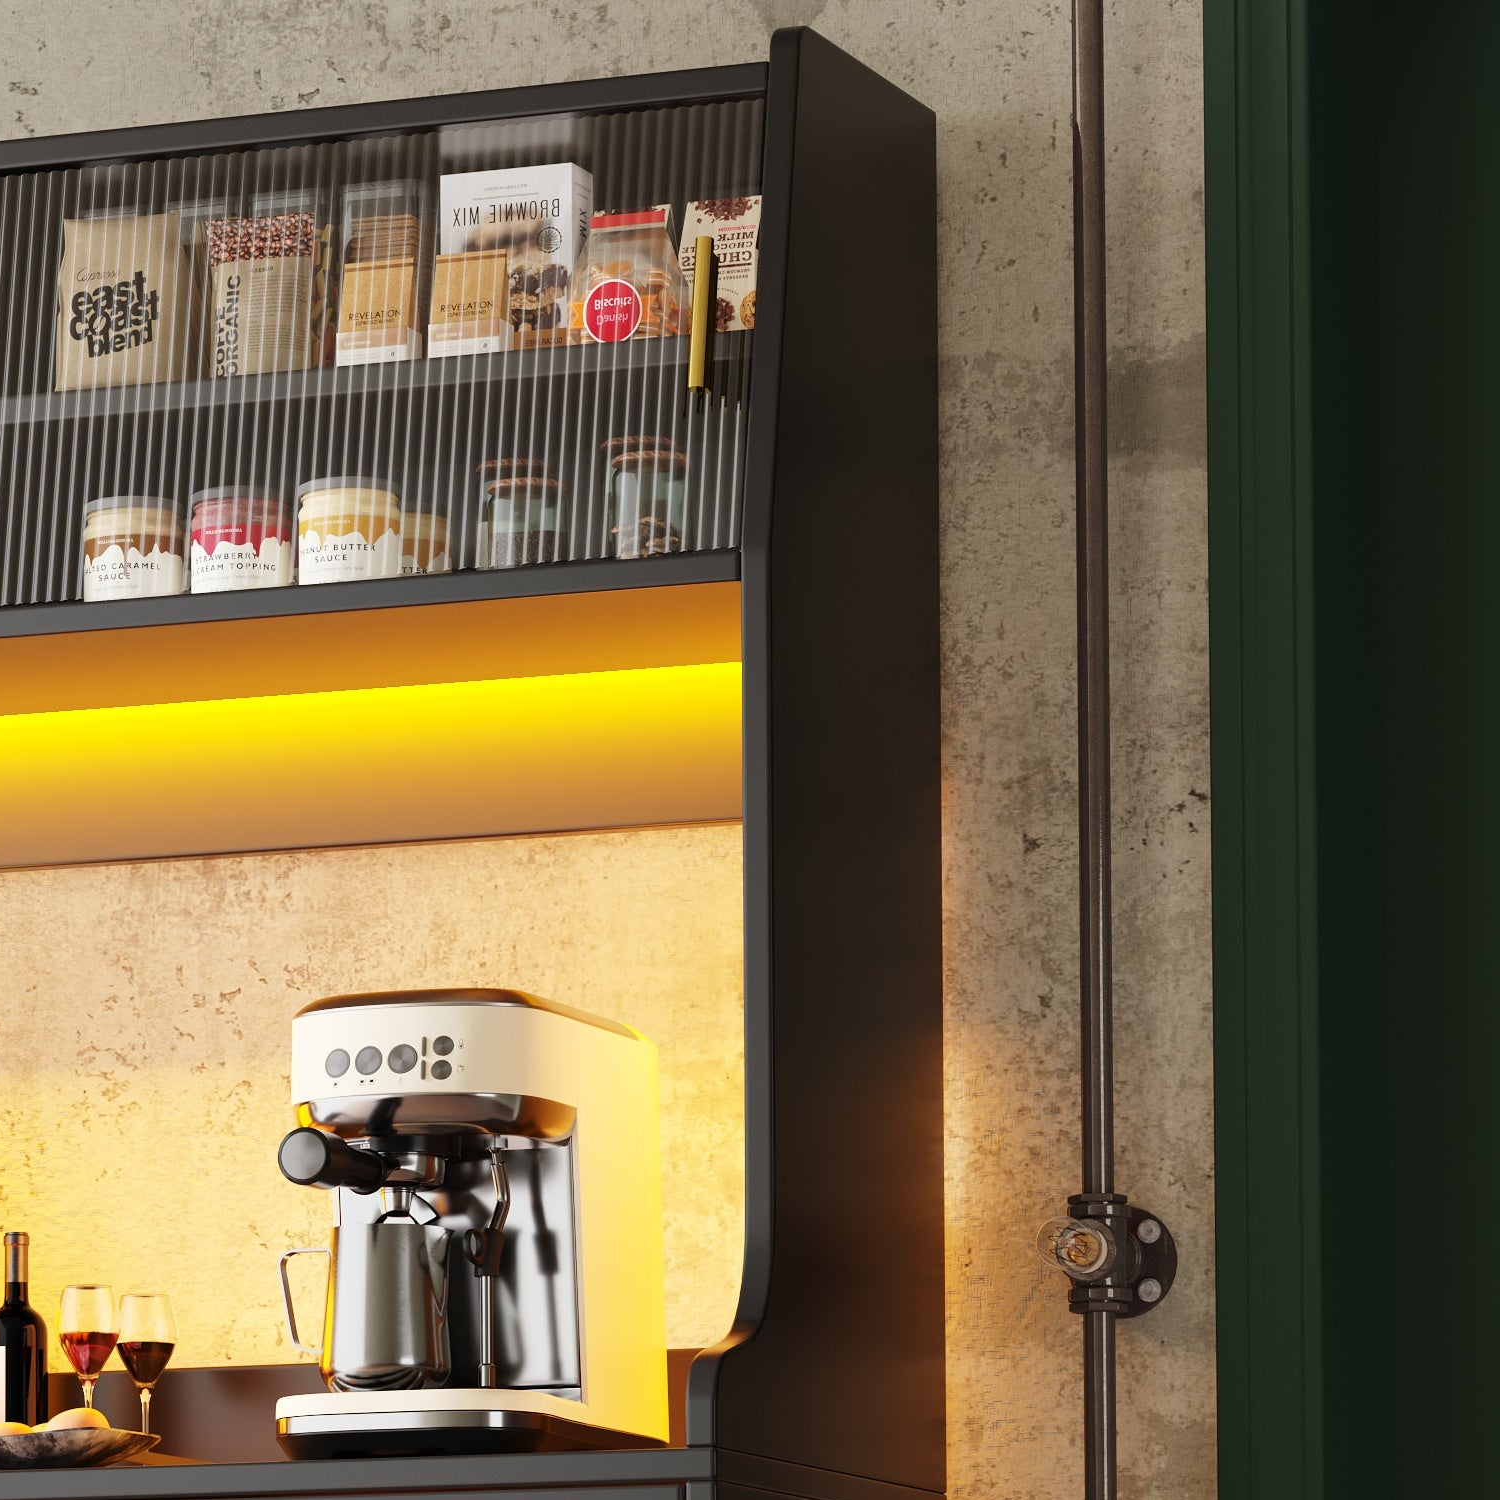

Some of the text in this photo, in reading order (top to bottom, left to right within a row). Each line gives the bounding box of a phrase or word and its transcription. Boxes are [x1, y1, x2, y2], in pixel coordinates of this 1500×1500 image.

[71, 270, 147, 316] east
[69, 289, 160, 341] coast
[348, 309, 402, 322] REVELATON
[225, 274, 242, 376] ORGANIC
[86, 319, 153, 359] blend
[333, 543, 376, 551] BUTTER
[195, 552, 257, 565] STRAWBERRY
[314, 553, 348, 564] SAUCE
[111, 561, 162, 571] CARAMEL
[196, 562, 224, 575] CREAM
[228, 562, 277, 572] TOPPING
[98, 572, 132, 582] SAUCE
